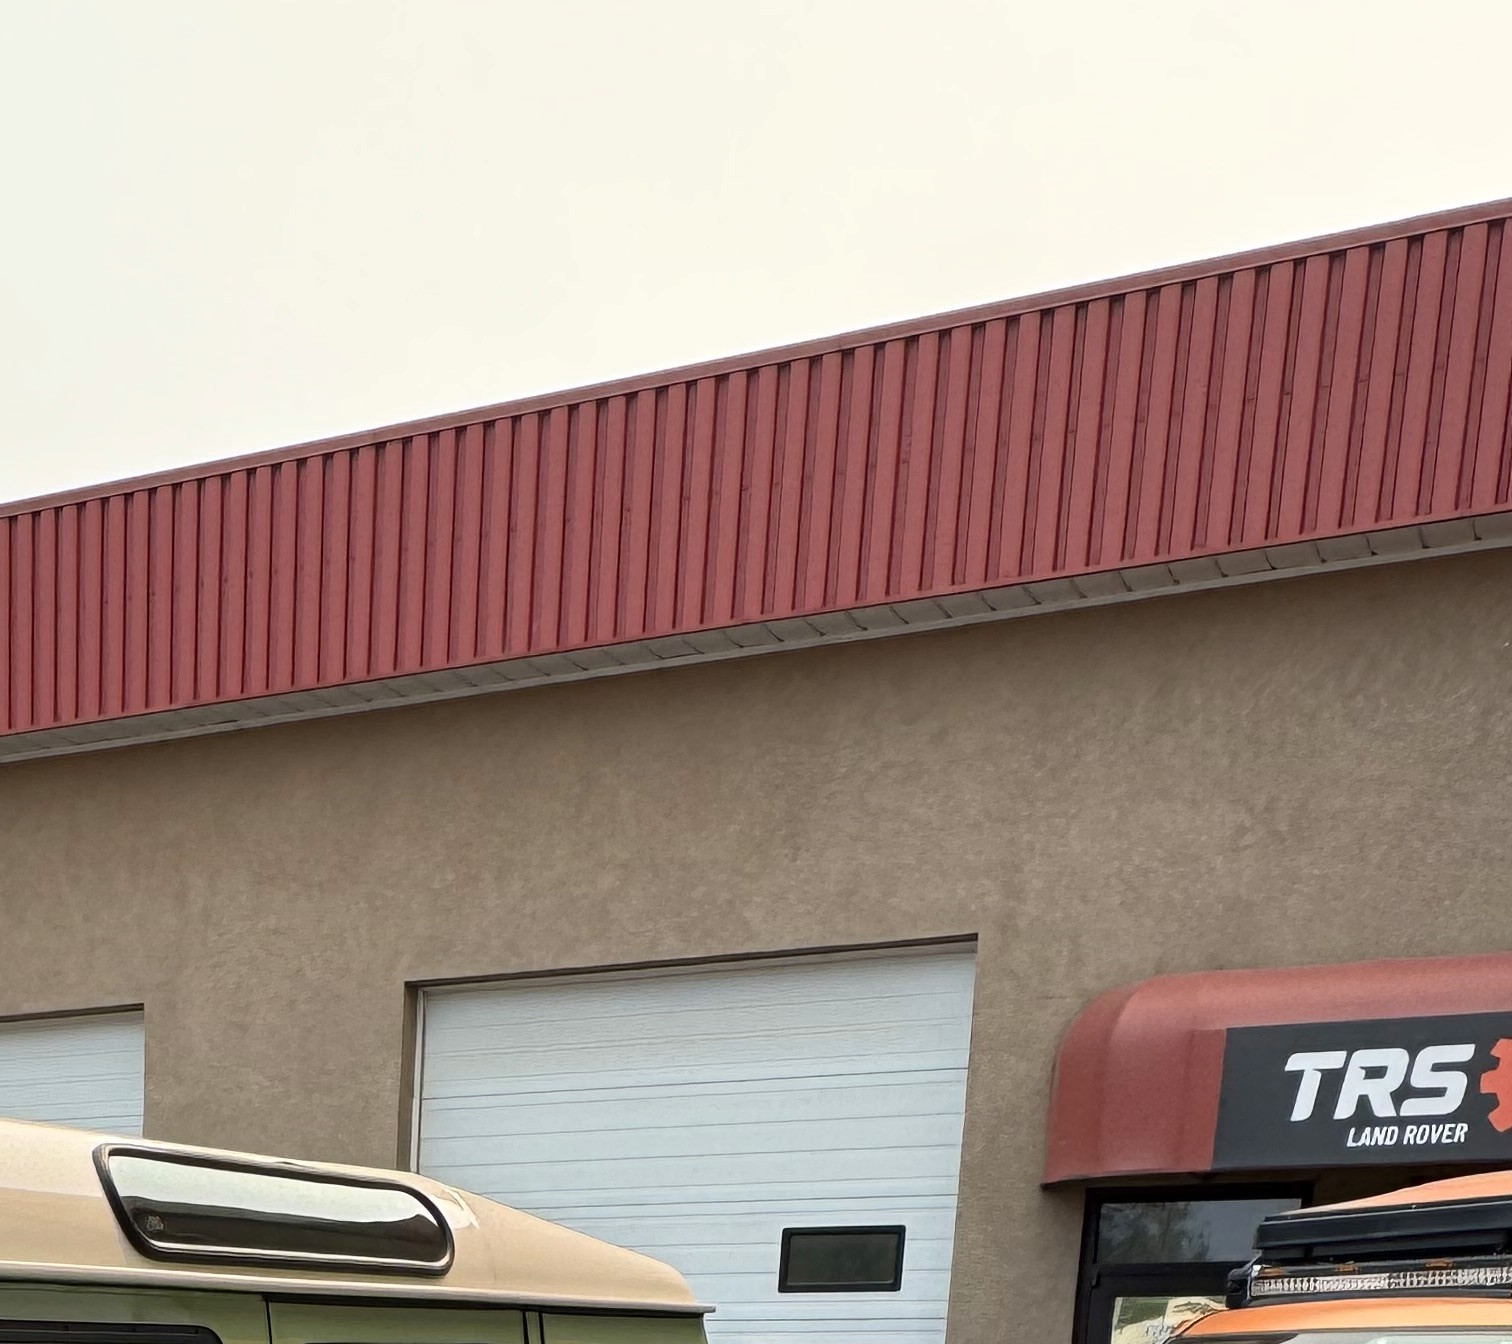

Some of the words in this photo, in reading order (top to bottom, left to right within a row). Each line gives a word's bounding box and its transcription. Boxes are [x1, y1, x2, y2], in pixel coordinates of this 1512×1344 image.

[1285, 1044, 1475, 1121] TRS
[1347, 1126, 1398, 1147] LAND
[1403, 1123, 1468, 1145] ROVER
